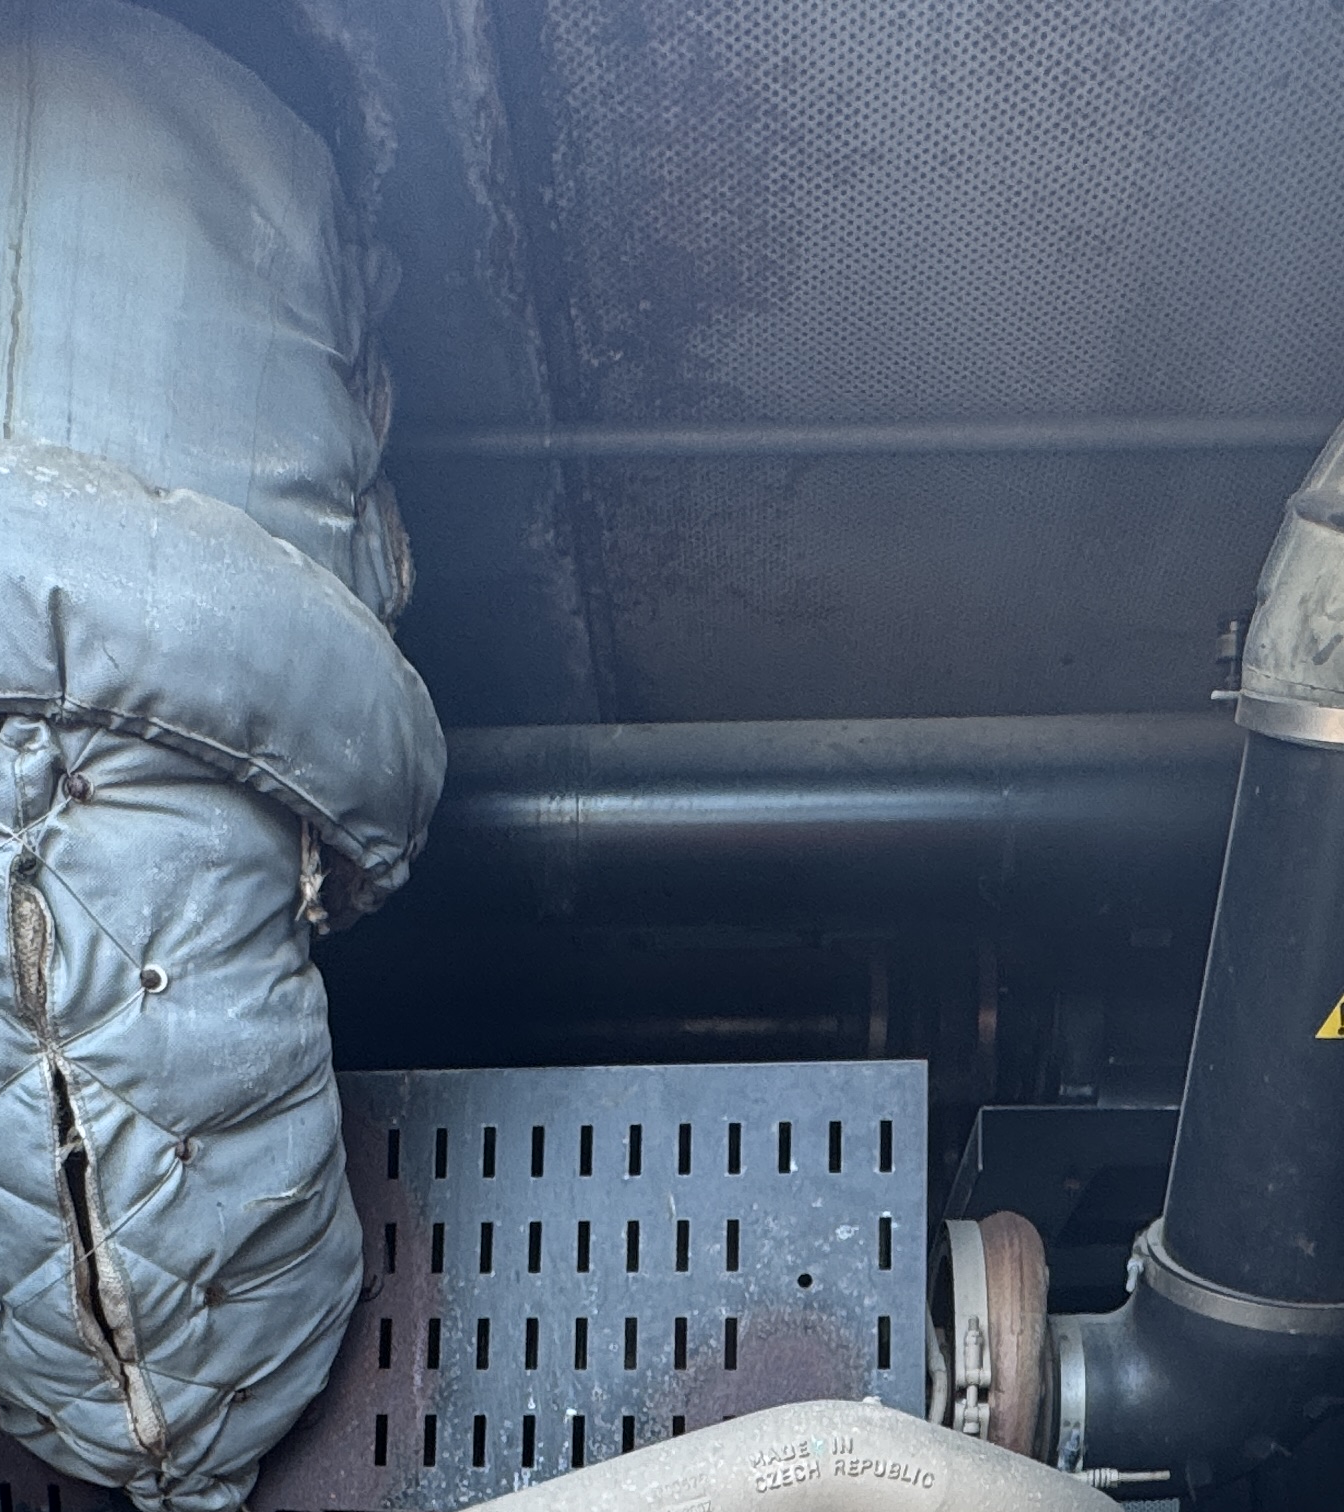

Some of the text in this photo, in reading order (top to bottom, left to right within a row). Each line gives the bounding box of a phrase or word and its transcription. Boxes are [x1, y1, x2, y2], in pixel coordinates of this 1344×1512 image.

[749, 1436, 854, 1469] MADE IN
[755, 1458, 936, 1494] CZECH REPUBLIC
